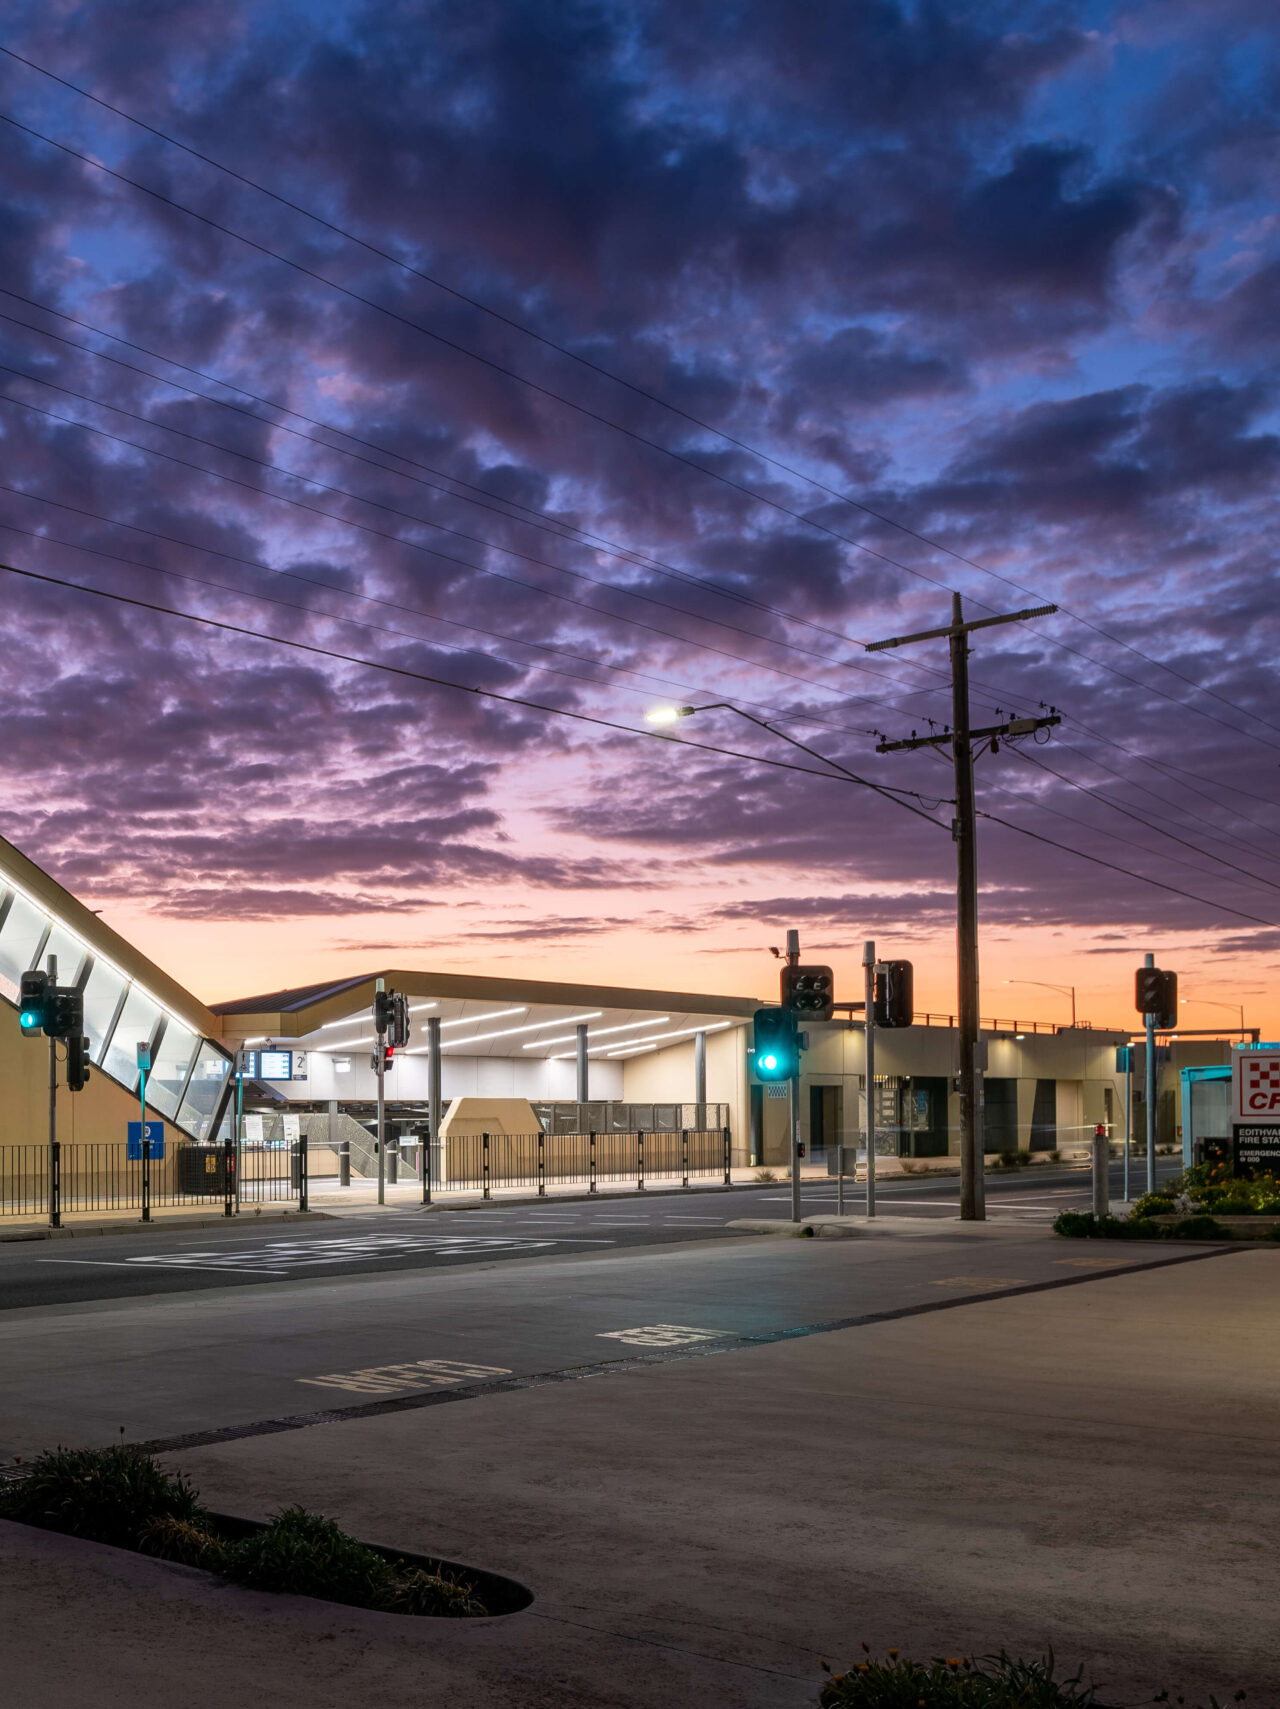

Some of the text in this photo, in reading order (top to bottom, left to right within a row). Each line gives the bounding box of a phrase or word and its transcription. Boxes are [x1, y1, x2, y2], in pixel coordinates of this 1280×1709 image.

[1239, 1136, 1280, 1144] FIRE STA
[125, 1236, 558, 1268] KEEP CLEAR
[295, 1324, 739, 1394] KEEP CLEAR
